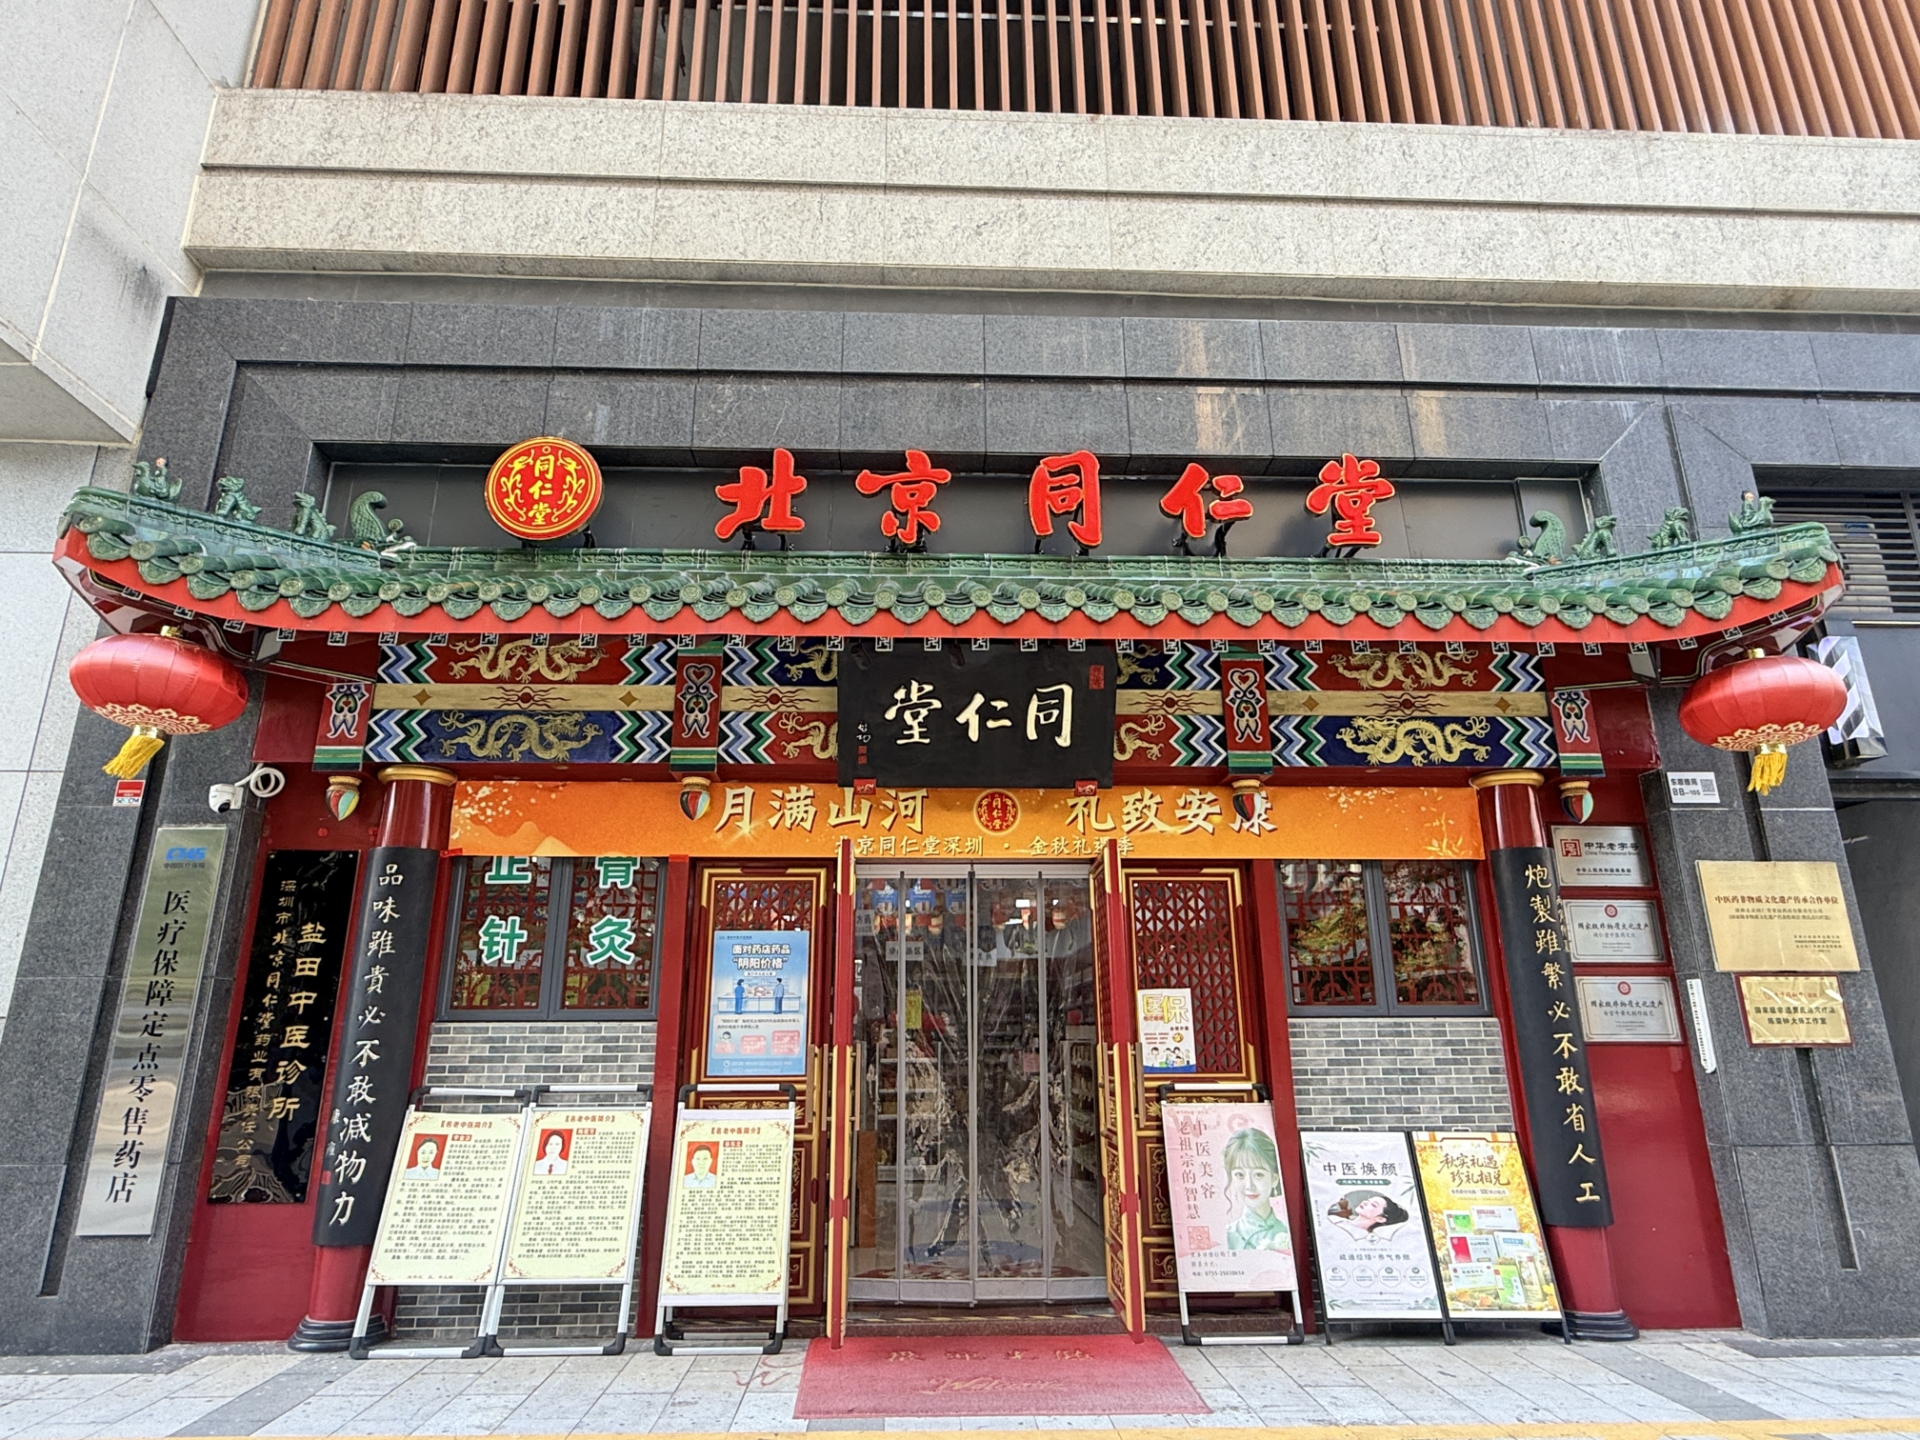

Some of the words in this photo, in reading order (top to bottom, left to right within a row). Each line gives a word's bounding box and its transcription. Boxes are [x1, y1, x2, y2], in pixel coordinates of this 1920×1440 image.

[526, 453, 556, 527] 同仁堂
[714, 447, 1397, 548] 北京同仁堂
[883, 680, 1074, 748] 同仁堂
[714, 785, 929, 833] 月满山河
[1584, 842, 1640, 851] 中华老字号
[732, 943, 791, 955] 面对药店药品
[1578, 922, 1649, 931] 国家级非物质文化遗产
[235, 880, 297, 1168] 深圳市北京同仁堂药业有限责任公司
[267, 921, 327, 1121] 盐田中医诊所
[1142, 993, 1189, 1024] 医保
[1590, 1000, 1664, 1009] 国家级非物质文化遗产
[105, 889, 191, 1203] 医疗保障定点零售药店
[1178, 1121, 1201, 1221] 老祖宗的智慧
[1194, 1119, 1216, 1200] 中医美容
[1323, 1162, 1398, 1177] 中医焕颜
